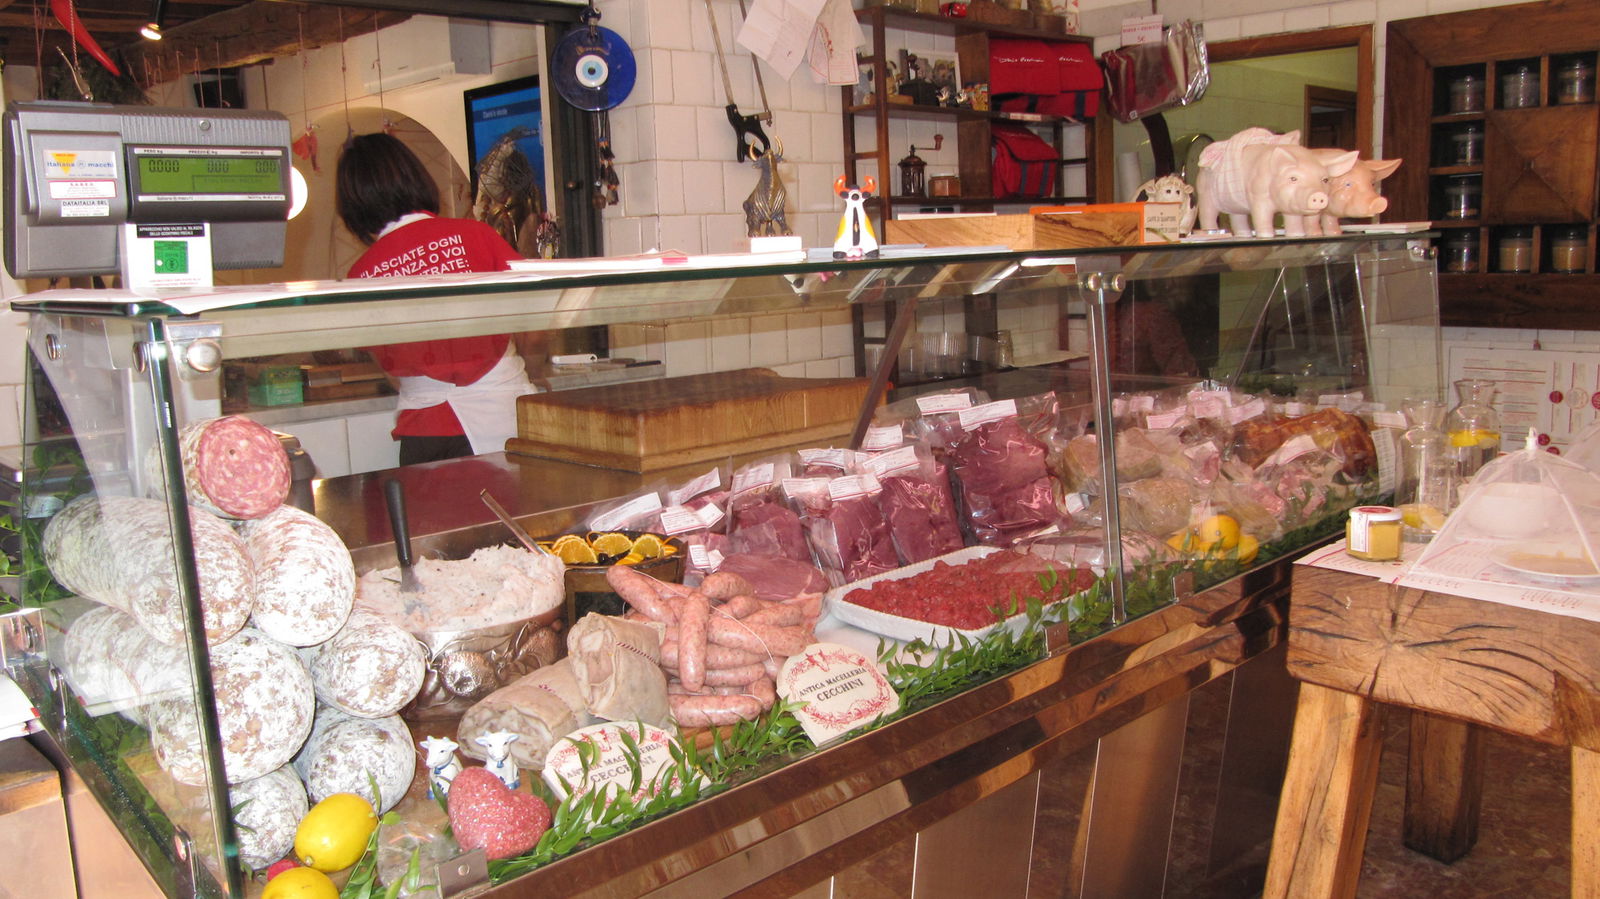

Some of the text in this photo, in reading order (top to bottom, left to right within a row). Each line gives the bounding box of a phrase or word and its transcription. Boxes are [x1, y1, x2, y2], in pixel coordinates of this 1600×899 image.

[428, 234, 463, 251] OGNI
[429, 253, 439, 264] O
[441, 246, 466, 259] VOI
[799, 667, 867, 697] ANTICA MACELLERIA
[816, 678, 864, 703] CECCHINI
